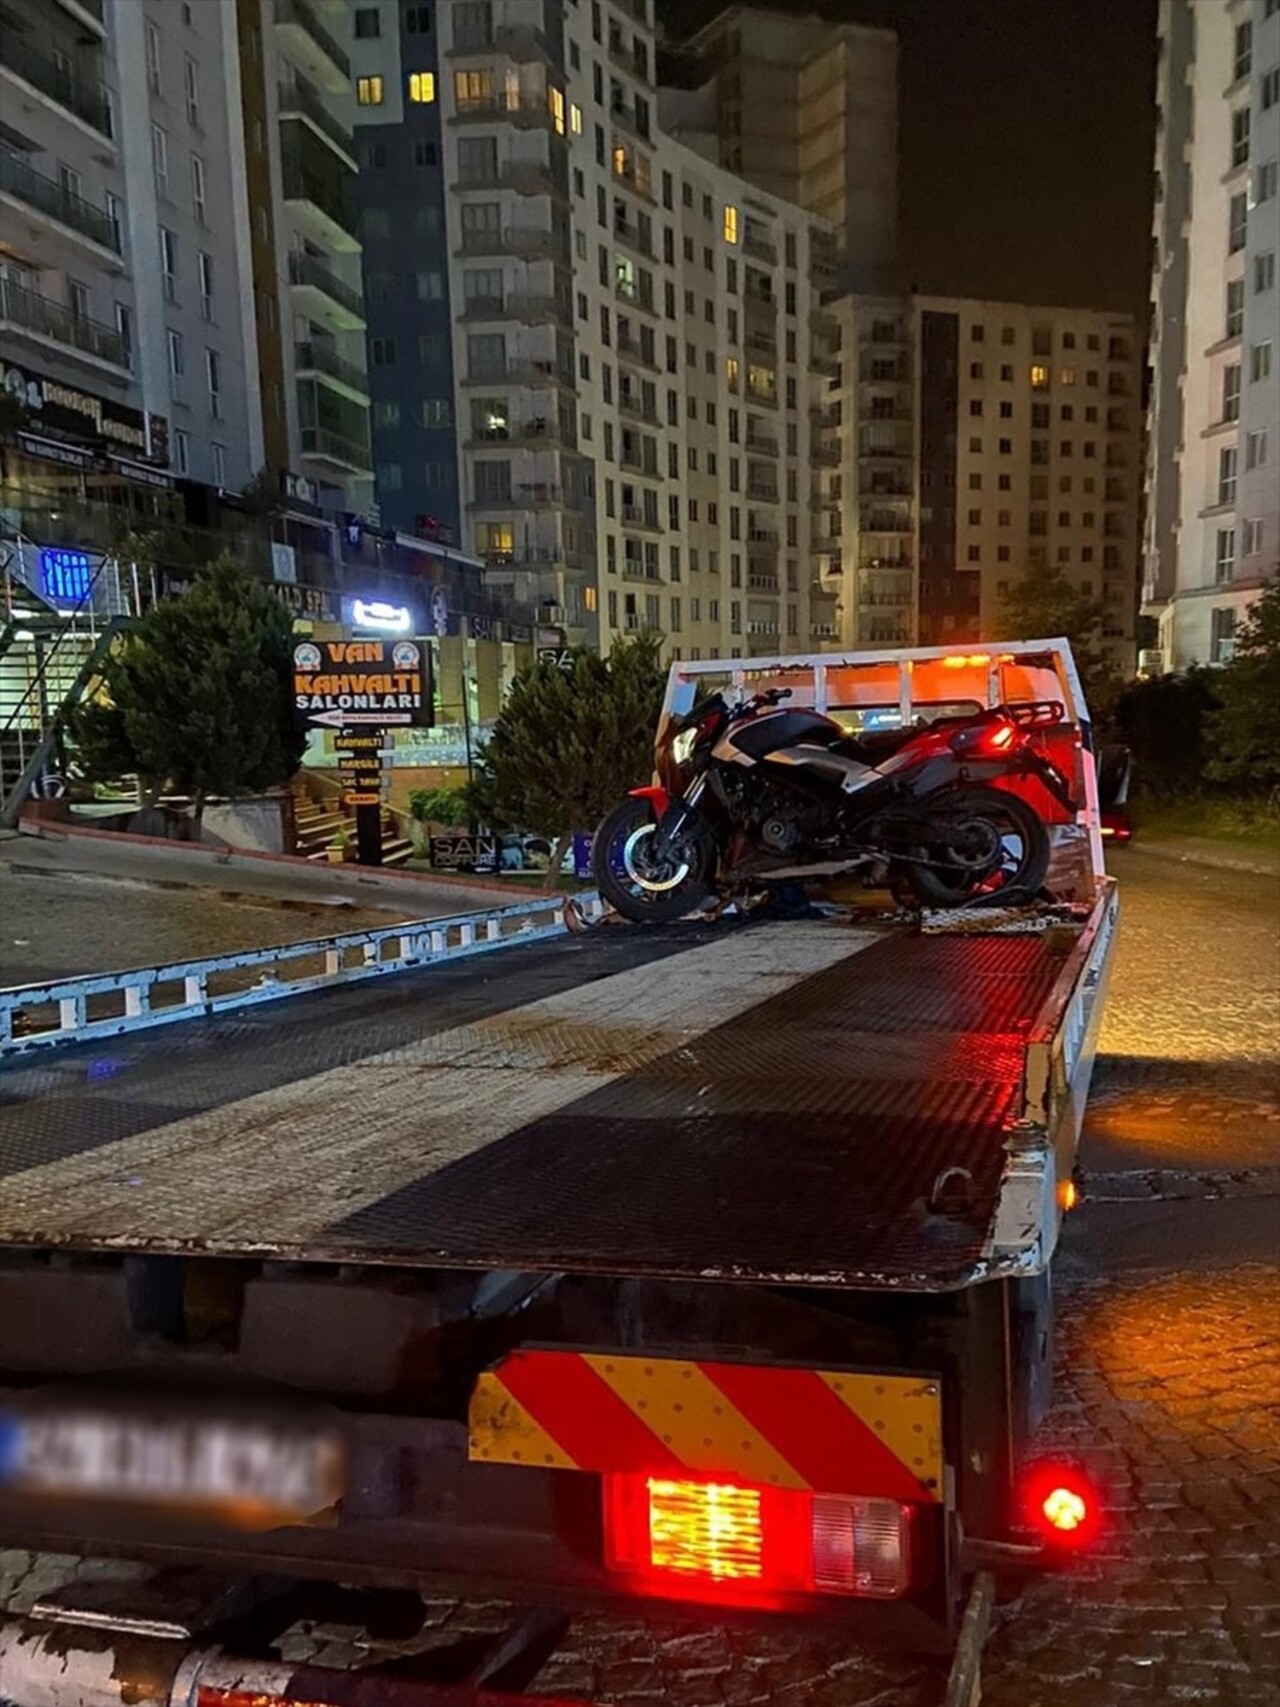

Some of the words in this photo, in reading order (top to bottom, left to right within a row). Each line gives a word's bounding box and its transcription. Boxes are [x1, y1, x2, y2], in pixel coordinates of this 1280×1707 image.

[328, 643, 384, 664] VAN
[295, 674, 421, 695] KAHVALTI
[296, 694, 421, 709] SALONLARI
[434, 838, 496, 856] SAN
[434, 853, 496, 866] COIFFURE
